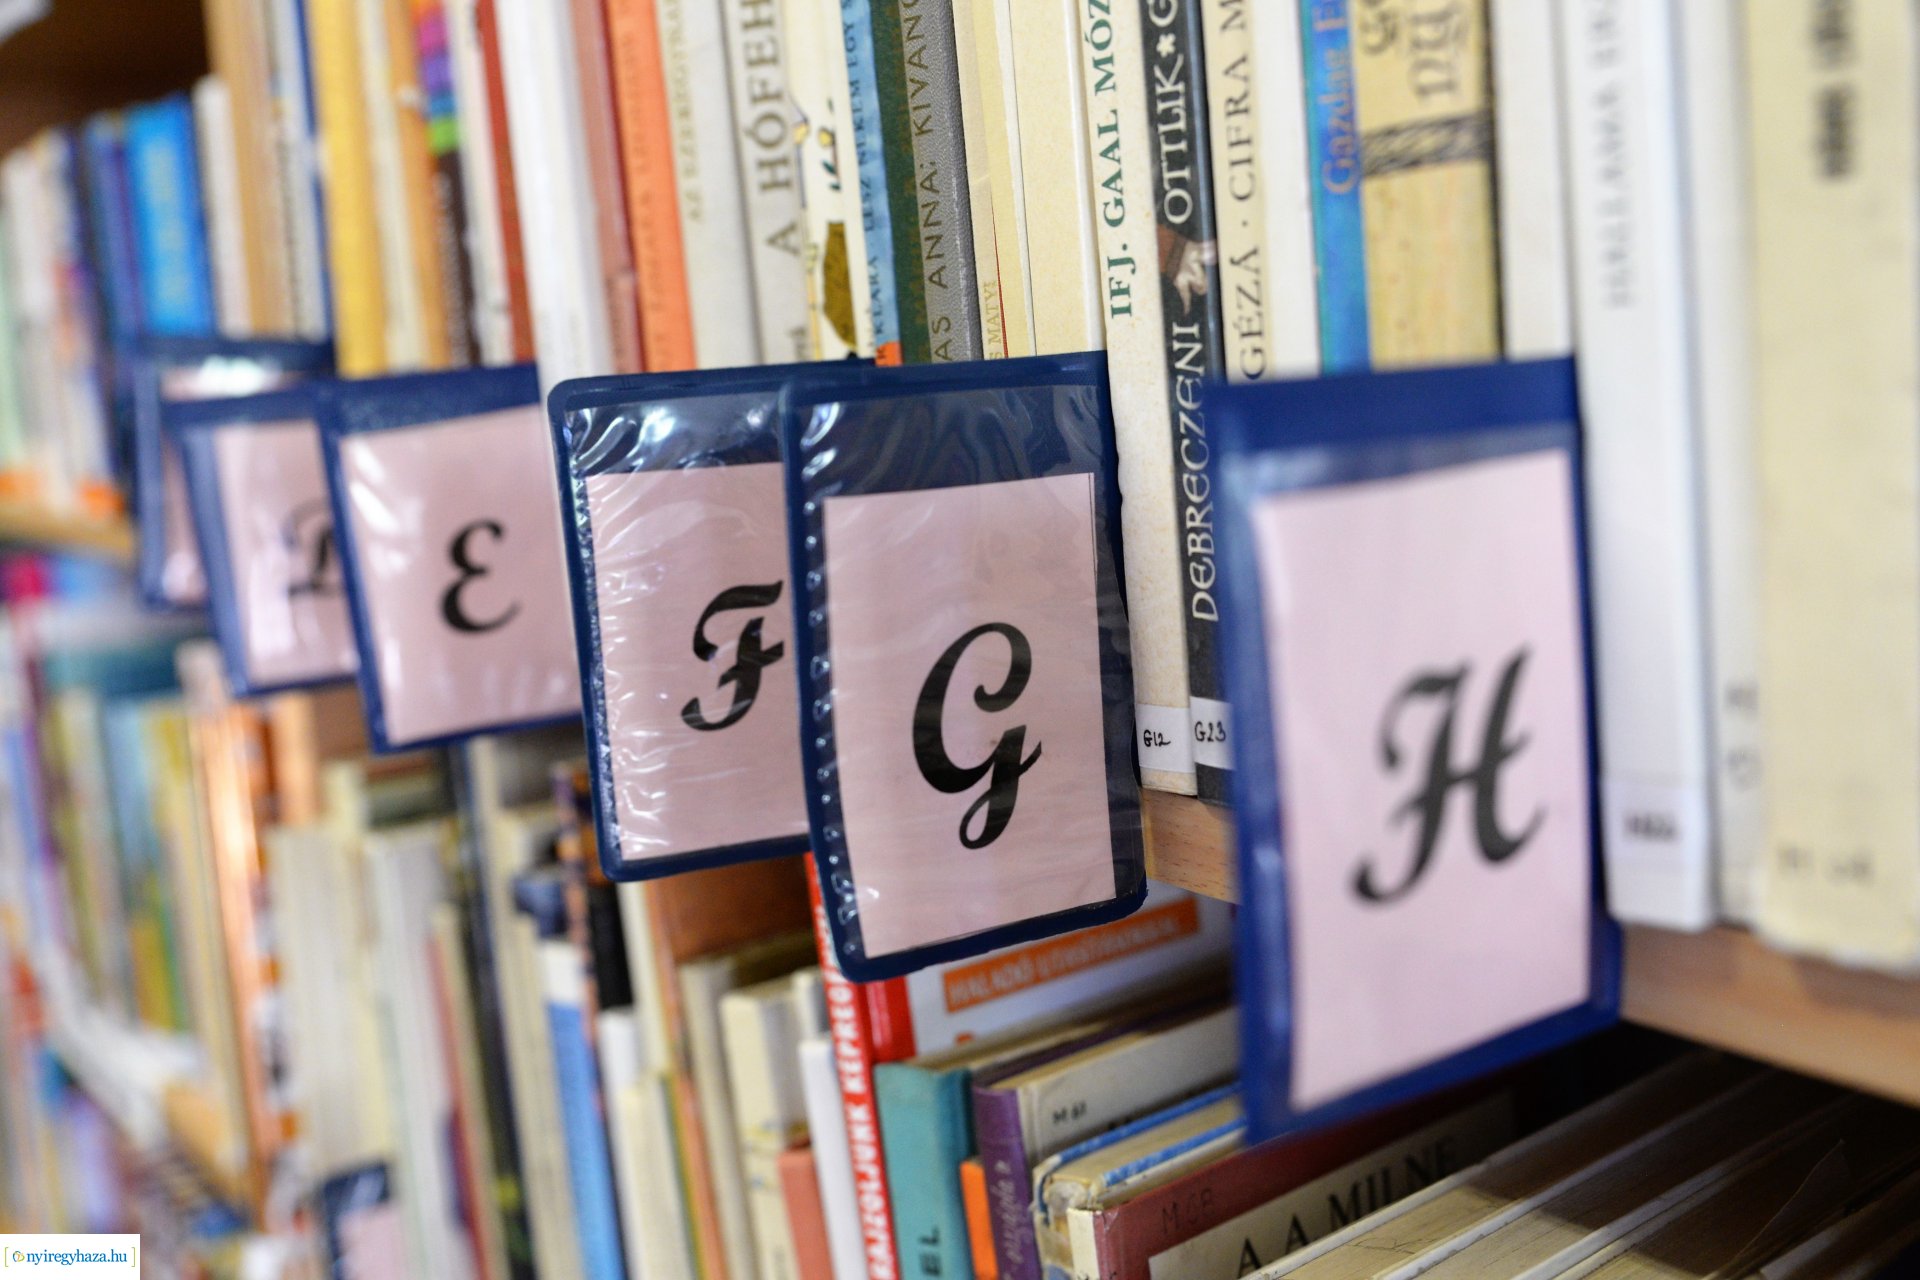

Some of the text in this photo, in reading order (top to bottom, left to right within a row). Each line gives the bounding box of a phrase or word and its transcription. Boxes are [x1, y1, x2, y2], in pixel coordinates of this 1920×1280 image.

[1097, 108, 1128, 229] GAAL
[1222, 55, 1257, 202] CIFRA
[766, 222, 801, 258] A
[920, 160, 949, 289] ANNA:
[1108, 242, 1137, 320] IFJ.
[1172, 321, 1220, 623] DEBRECZENI
[439, 518, 523, 635] E
[680, 579, 785, 732] F
[912, 621, 1043, 851] G
[1194, 720, 1227, 743] G23
[1348, 642, 1547, 905] H
